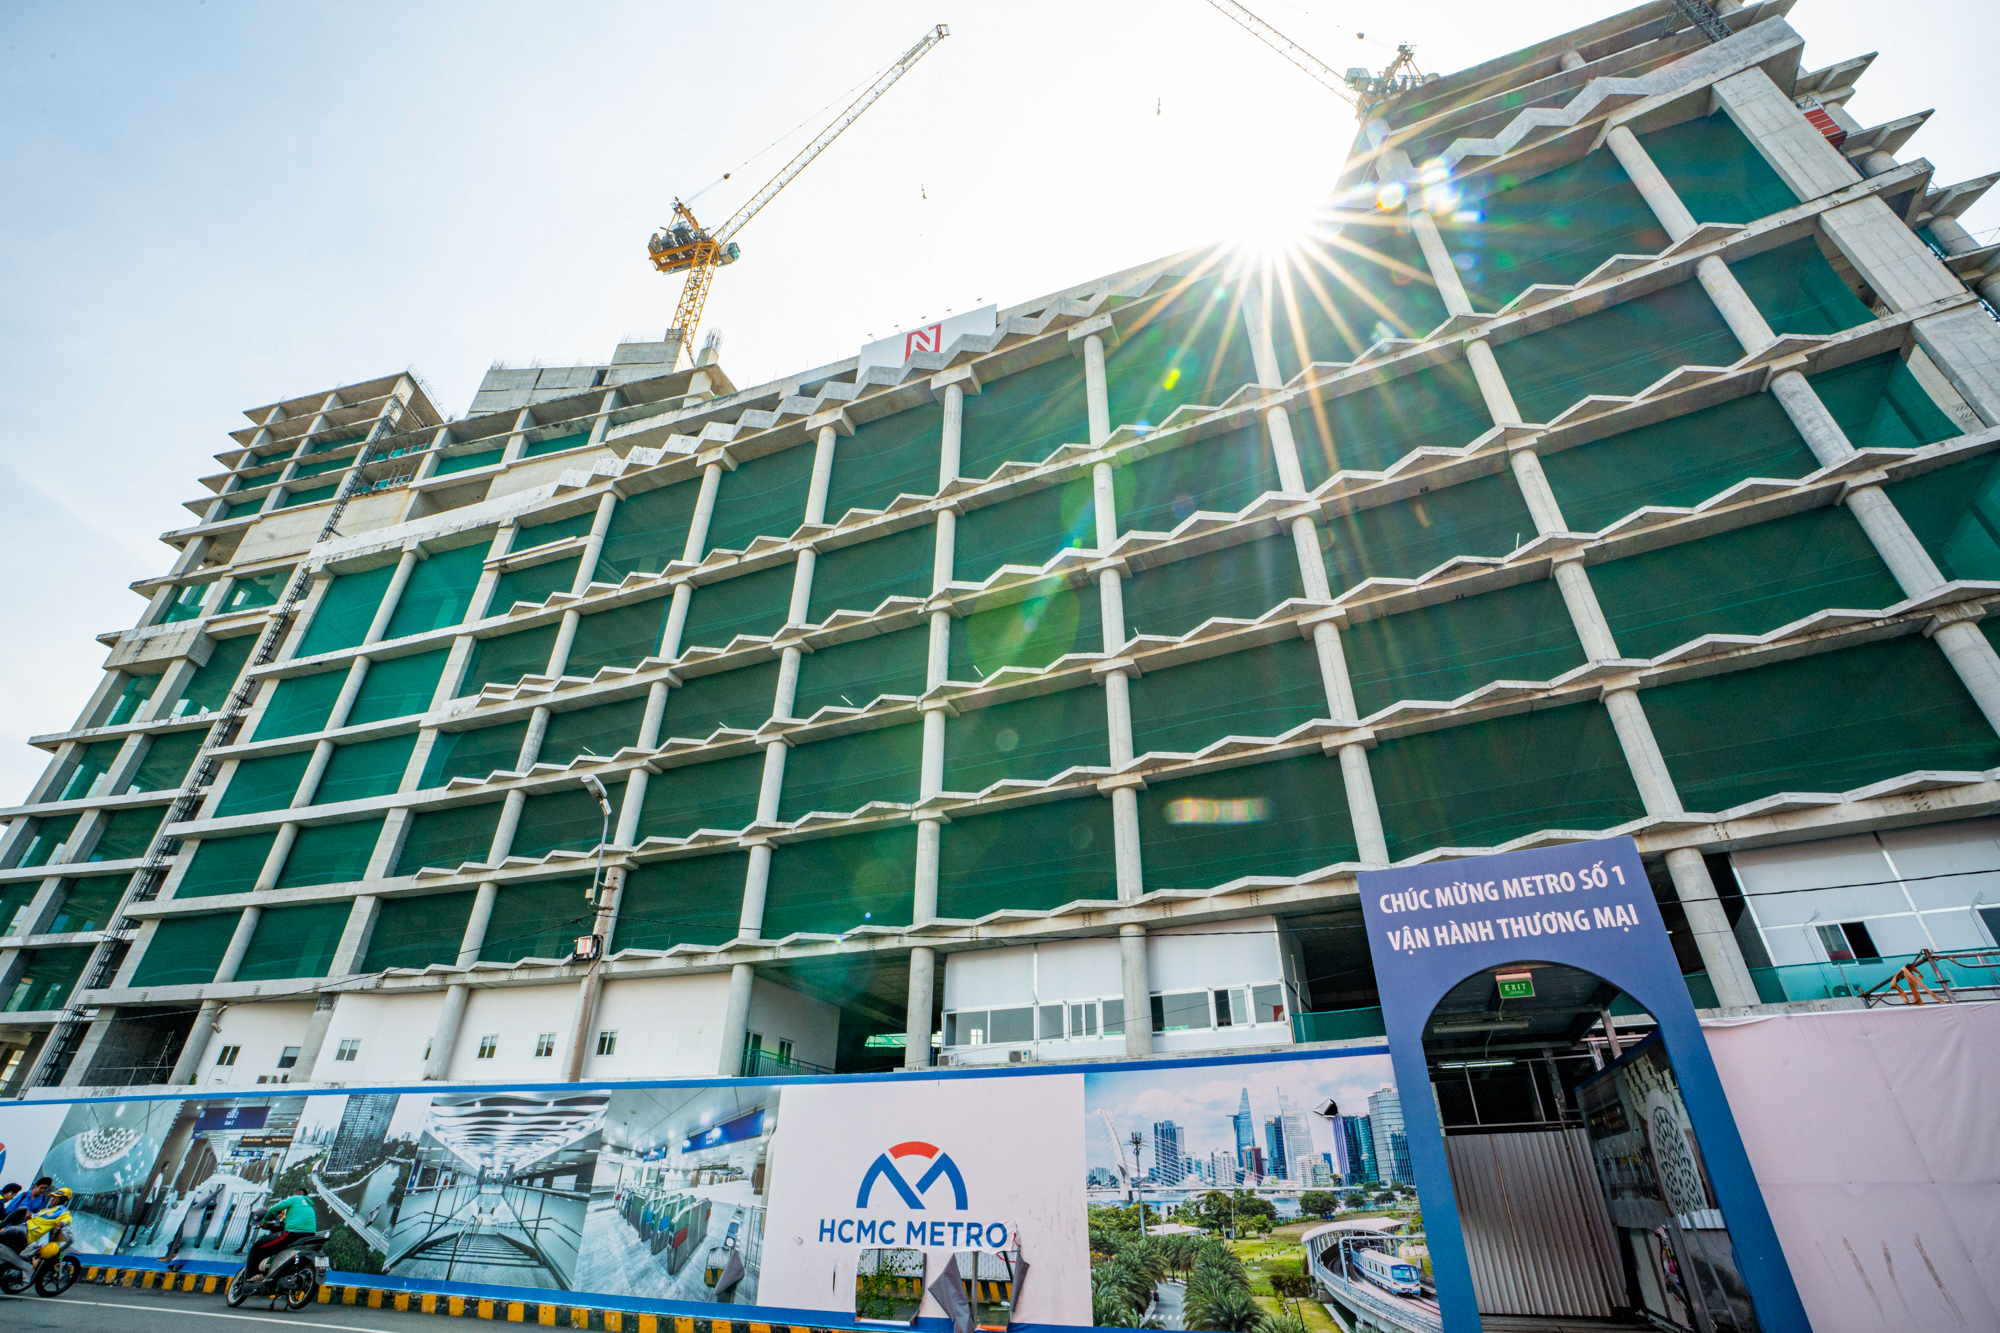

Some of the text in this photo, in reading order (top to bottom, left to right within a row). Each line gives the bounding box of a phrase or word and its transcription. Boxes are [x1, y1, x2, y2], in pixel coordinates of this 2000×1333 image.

[1379, 860, 1626, 914] CHÚC MỪNG METRO SỐ 1
[1386, 904, 1640, 955] VẬN HÀNH THƯƠNG MẠI
[1504, 982, 1527, 992] EXIT
[818, 1218, 1008, 1249] HCMC METRO
